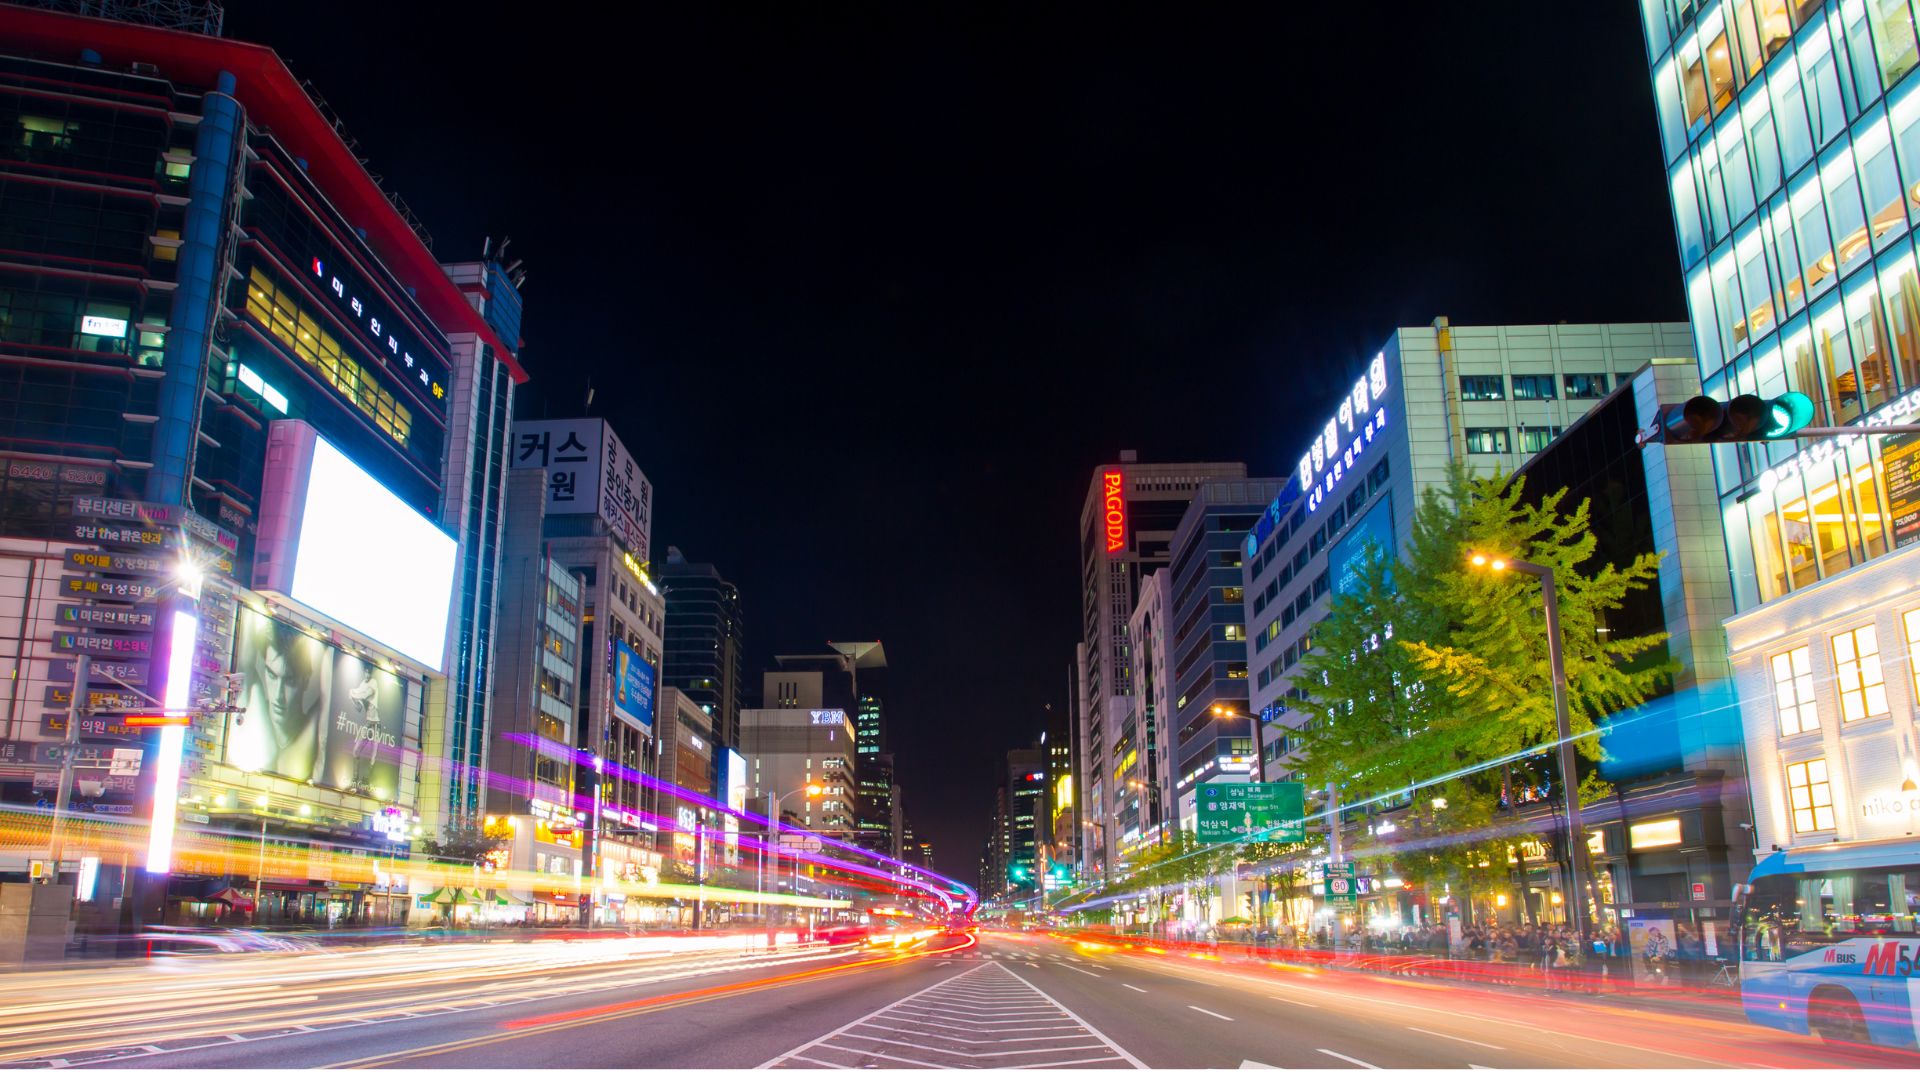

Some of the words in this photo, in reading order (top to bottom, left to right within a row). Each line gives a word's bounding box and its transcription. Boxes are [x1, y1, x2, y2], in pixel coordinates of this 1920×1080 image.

[509, 431, 589, 468] 커스
[77, 499, 136, 517] 뷰티센터
[1105, 473, 1124, 552] PAGODA
[75, 525, 97, 538] 강남
[99, 527, 119, 541] the
[811, 710, 844, 725] YBM
[1230, 788, 1245, 797] 성남
[1219, 801, 1246, 811] 양재역
[1200, 820, 1229, 829] 역삼역
[1334, 881, 1346, 891] 90
